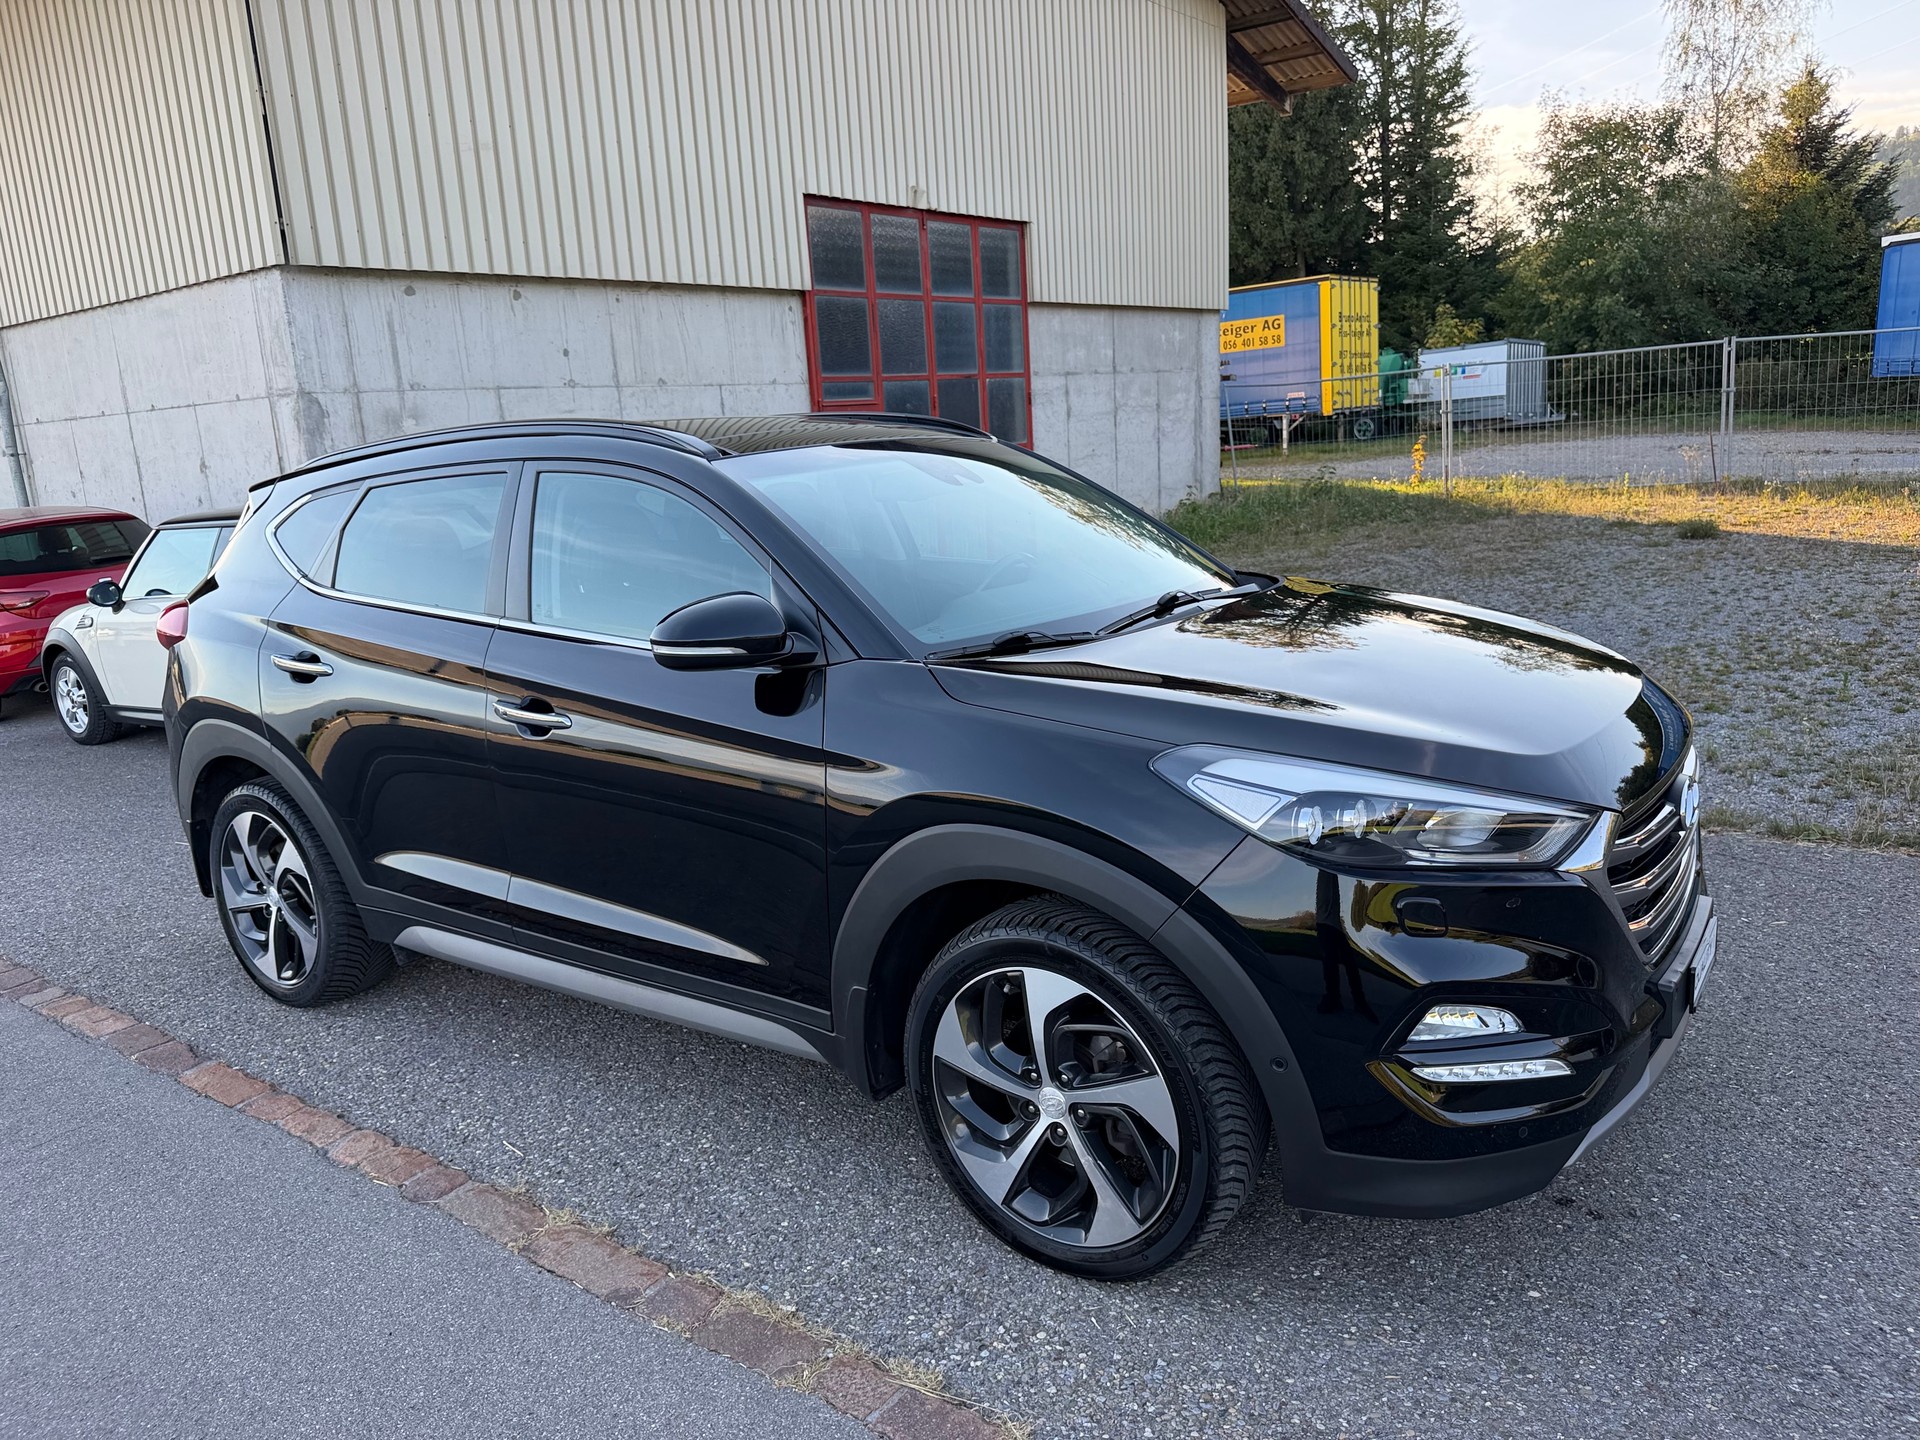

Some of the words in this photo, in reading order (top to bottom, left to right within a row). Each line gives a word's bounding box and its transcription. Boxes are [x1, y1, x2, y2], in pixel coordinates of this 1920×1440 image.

[1219, 323, 1257, 338] eiger
[1262, 318, 1281, 331] AG
[1223, 340, 1237, 351] 056
[1241, 338, 1255, 348] 401
[1258, 336, 1268, 346] 58
[1271, 334, 1281, 345] 58
